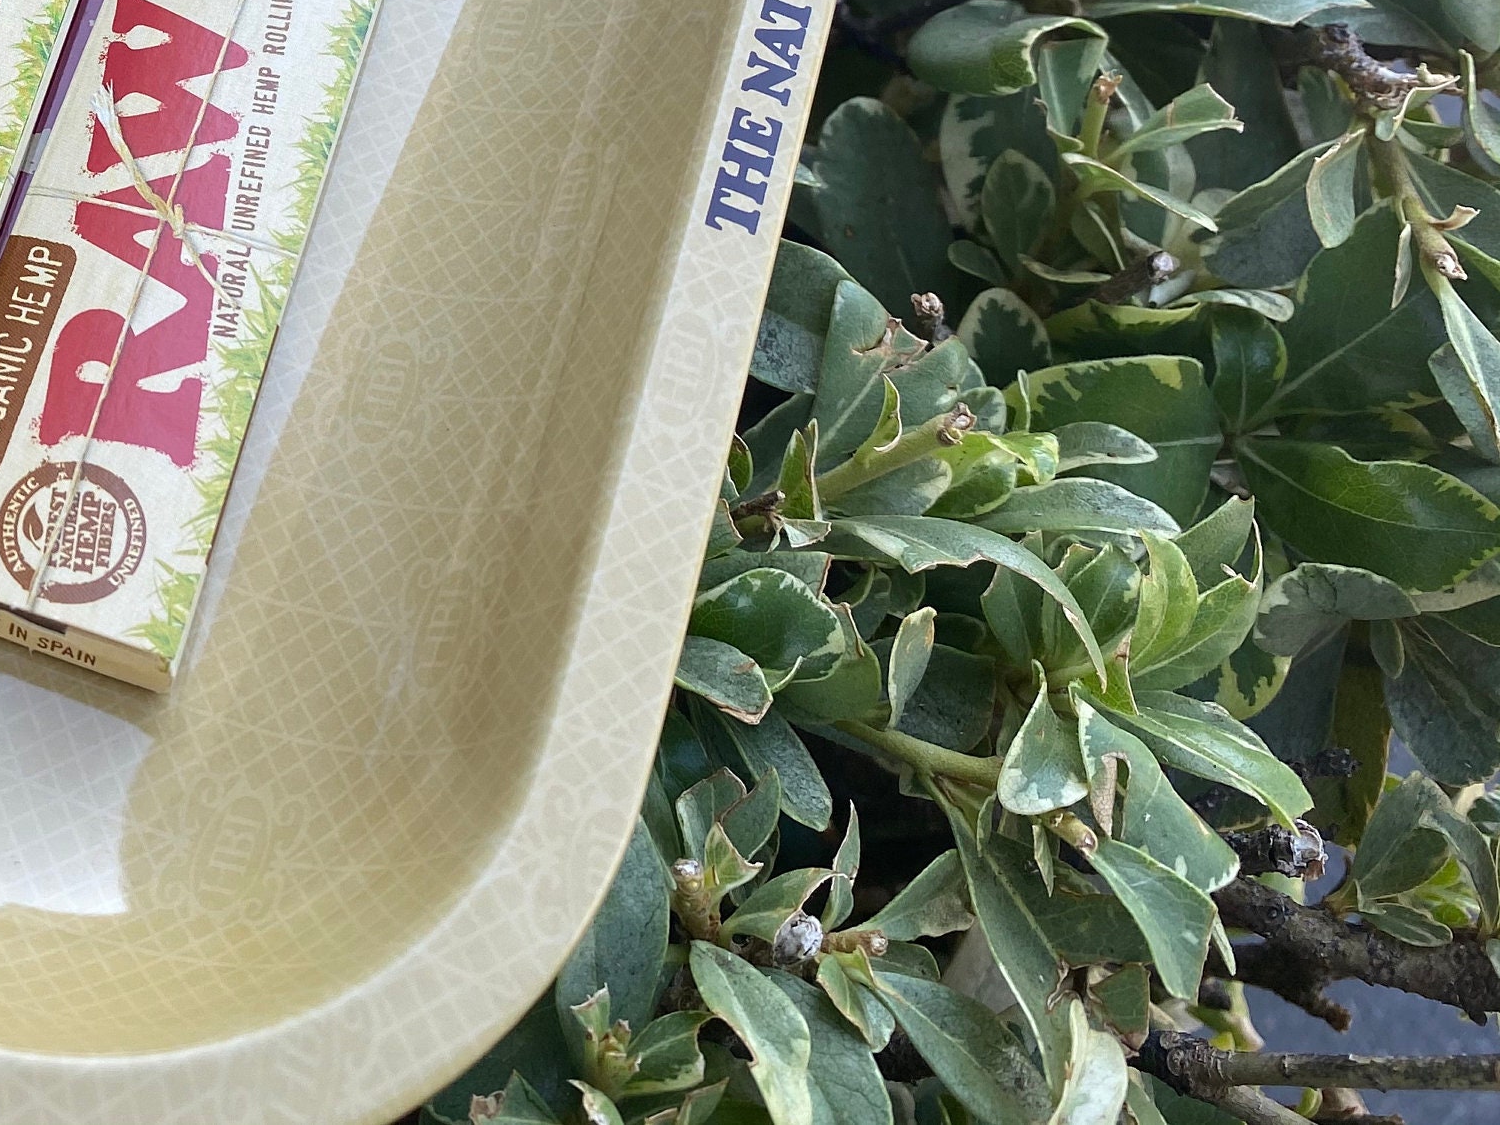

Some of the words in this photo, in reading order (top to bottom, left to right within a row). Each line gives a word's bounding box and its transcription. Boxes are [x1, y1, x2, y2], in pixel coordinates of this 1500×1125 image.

[212, 245, 252, 339] NATURAL
[232, 125, 271, 232] UNREFINED
[252, 66, 281, 116] HEMP
[706, 107, 782, 235] THE
[5, 243, 63, 328] HEMP
[3, 476, 40, 573] AUTHENTIC
[73, 490, 102, 575] HEMP
[108, 497, 144, 586] UNREFINED
[9, 622, 28, 642] IN
[37, 636, 96, 667] SPAIN
